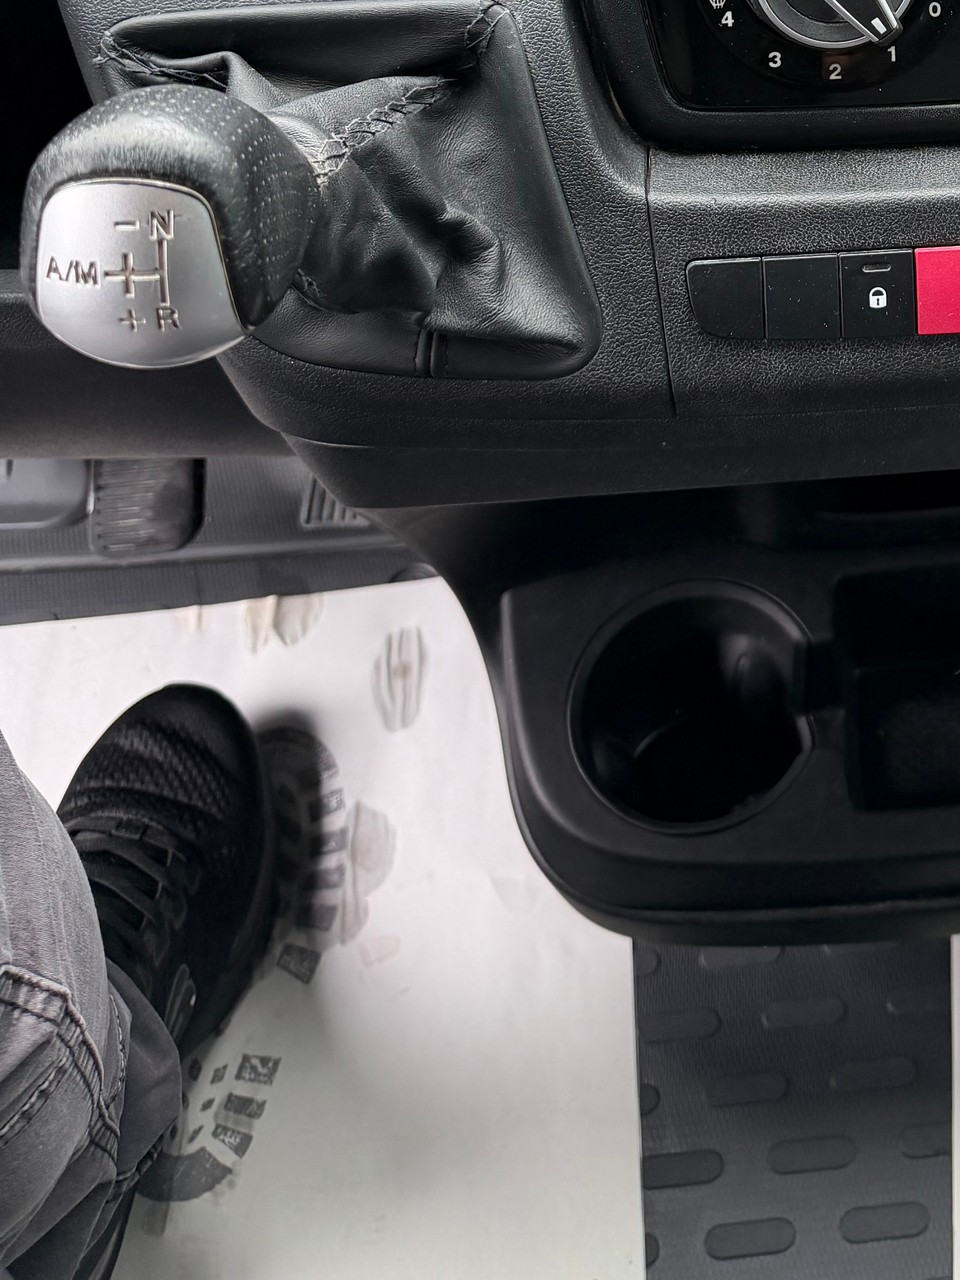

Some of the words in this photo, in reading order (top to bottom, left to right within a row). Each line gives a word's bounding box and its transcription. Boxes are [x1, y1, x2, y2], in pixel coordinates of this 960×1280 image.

[928, 1, 942, 18] 0
[720, 10, 735, 27] 4
[768, 51, 782, 68] 3
[887, 45, 896, 62] 1
[828, 63, 842, 80] 2
[149, 208, 176, 241] N
[45, 254, 101, 288] A/M
[156, 305, 183, 333] R
